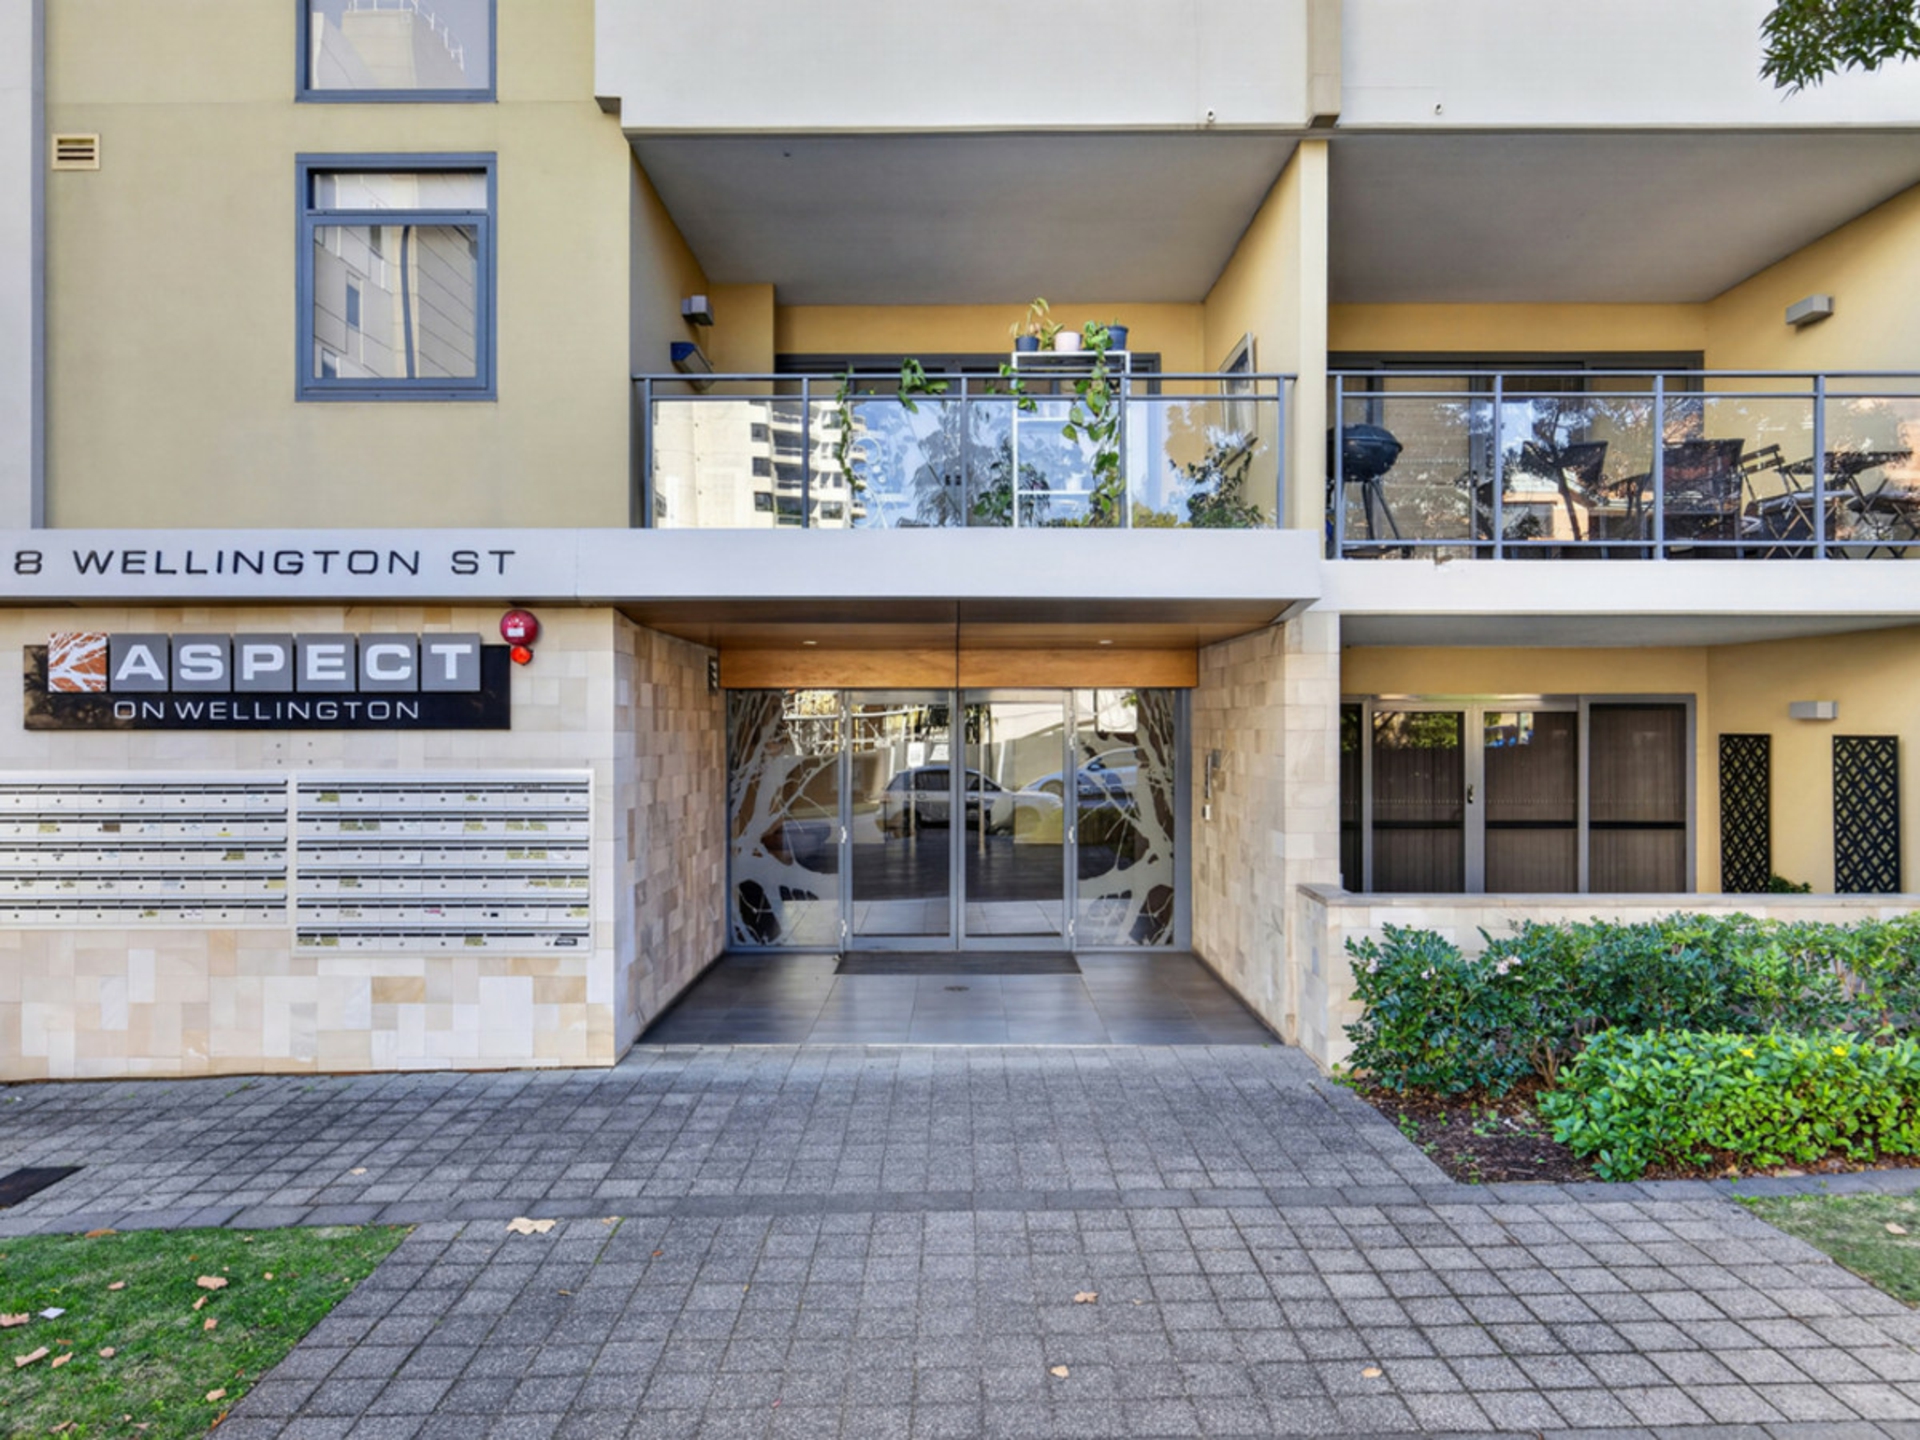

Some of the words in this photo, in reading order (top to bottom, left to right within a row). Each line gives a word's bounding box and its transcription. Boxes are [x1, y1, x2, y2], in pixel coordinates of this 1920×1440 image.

[14, 549, 43, 576] 8
[72, 549, 420, 576] WELLINGTON
[450, 549, 516, 576] ST
[115, 644, 473, 681] ASPECT
[113, 700, 165, 720] ON
[173, 700, 419, 720] WELLINGTON
